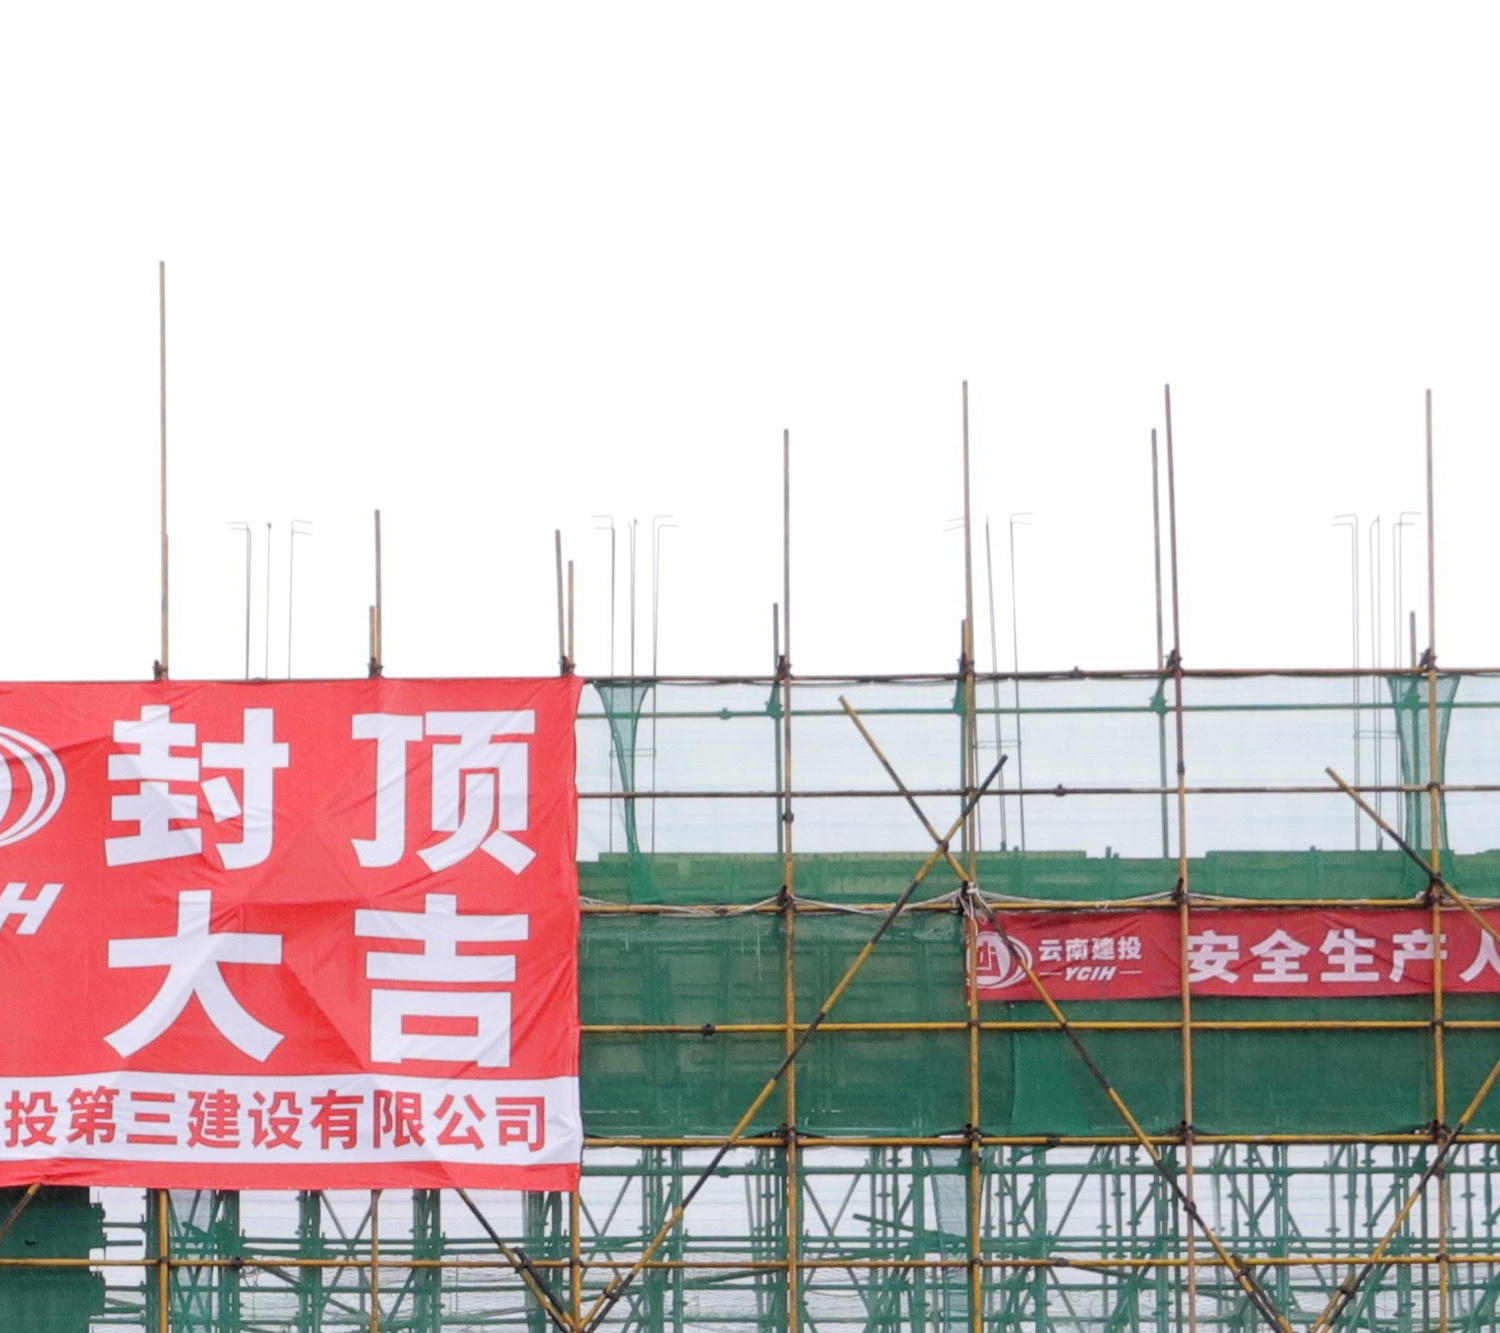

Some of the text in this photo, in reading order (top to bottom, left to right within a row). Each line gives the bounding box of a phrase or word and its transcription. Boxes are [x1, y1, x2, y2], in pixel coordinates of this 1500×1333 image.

[105, 705, 536, 874] 封顶
[104, 890, 530, 1068] 大吉
[1038, 936, 1142, 962] 云南建投
[1064, 966, 1117, 981] YCIH
